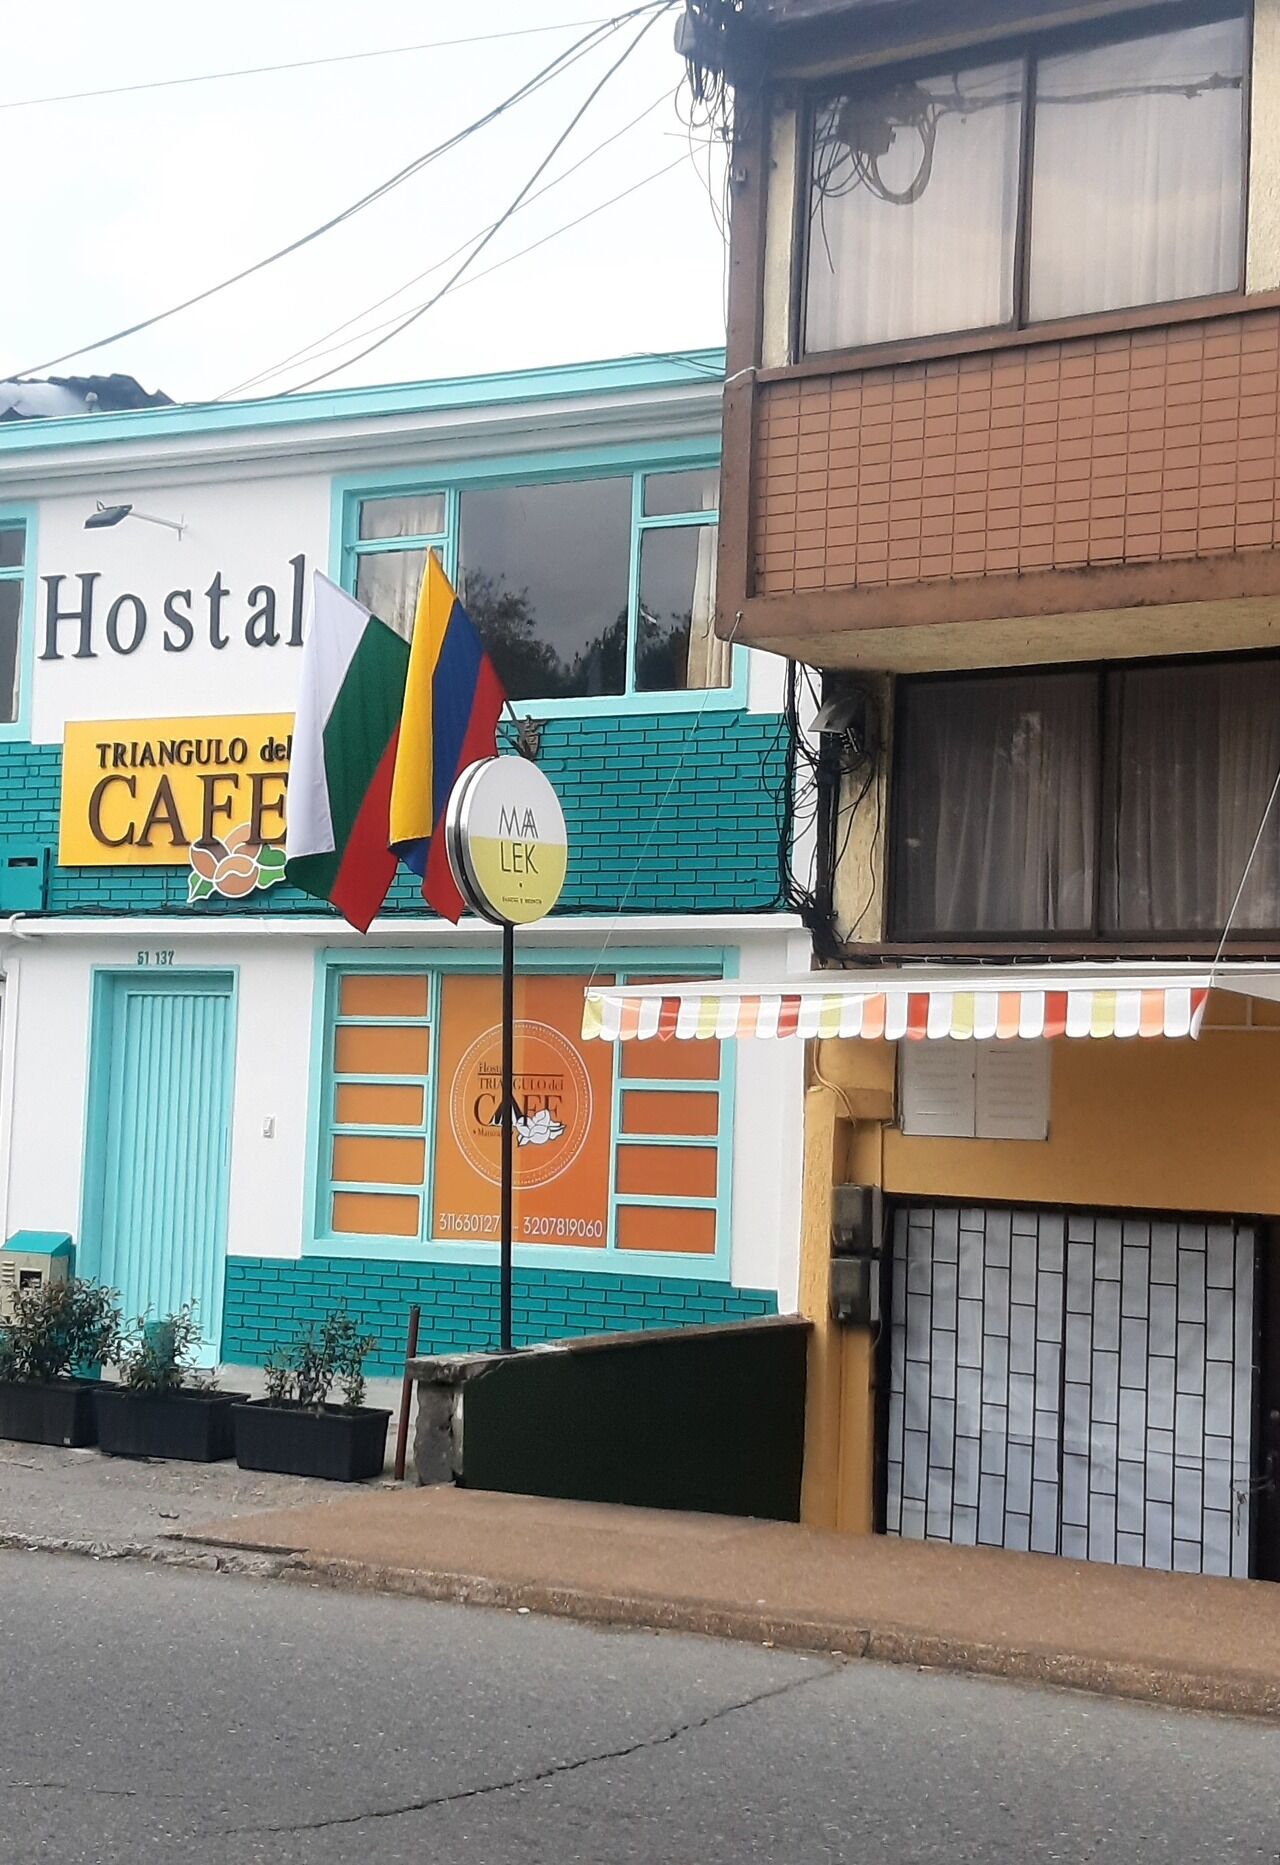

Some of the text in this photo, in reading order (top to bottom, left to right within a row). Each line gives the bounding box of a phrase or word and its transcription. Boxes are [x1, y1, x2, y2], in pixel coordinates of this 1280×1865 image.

[38, 553, 306, 660] Hostal
[96, 735, 293, 768] TRIANGULO del
[88, 772, 289, 848] CAFE
[500, 841, 539, 875] LEK
[137, 950, 175, 965] 51 137
[439, 1212, 501, 1233] 311630127
[523, 1216, 603, 1238] 3207819060
